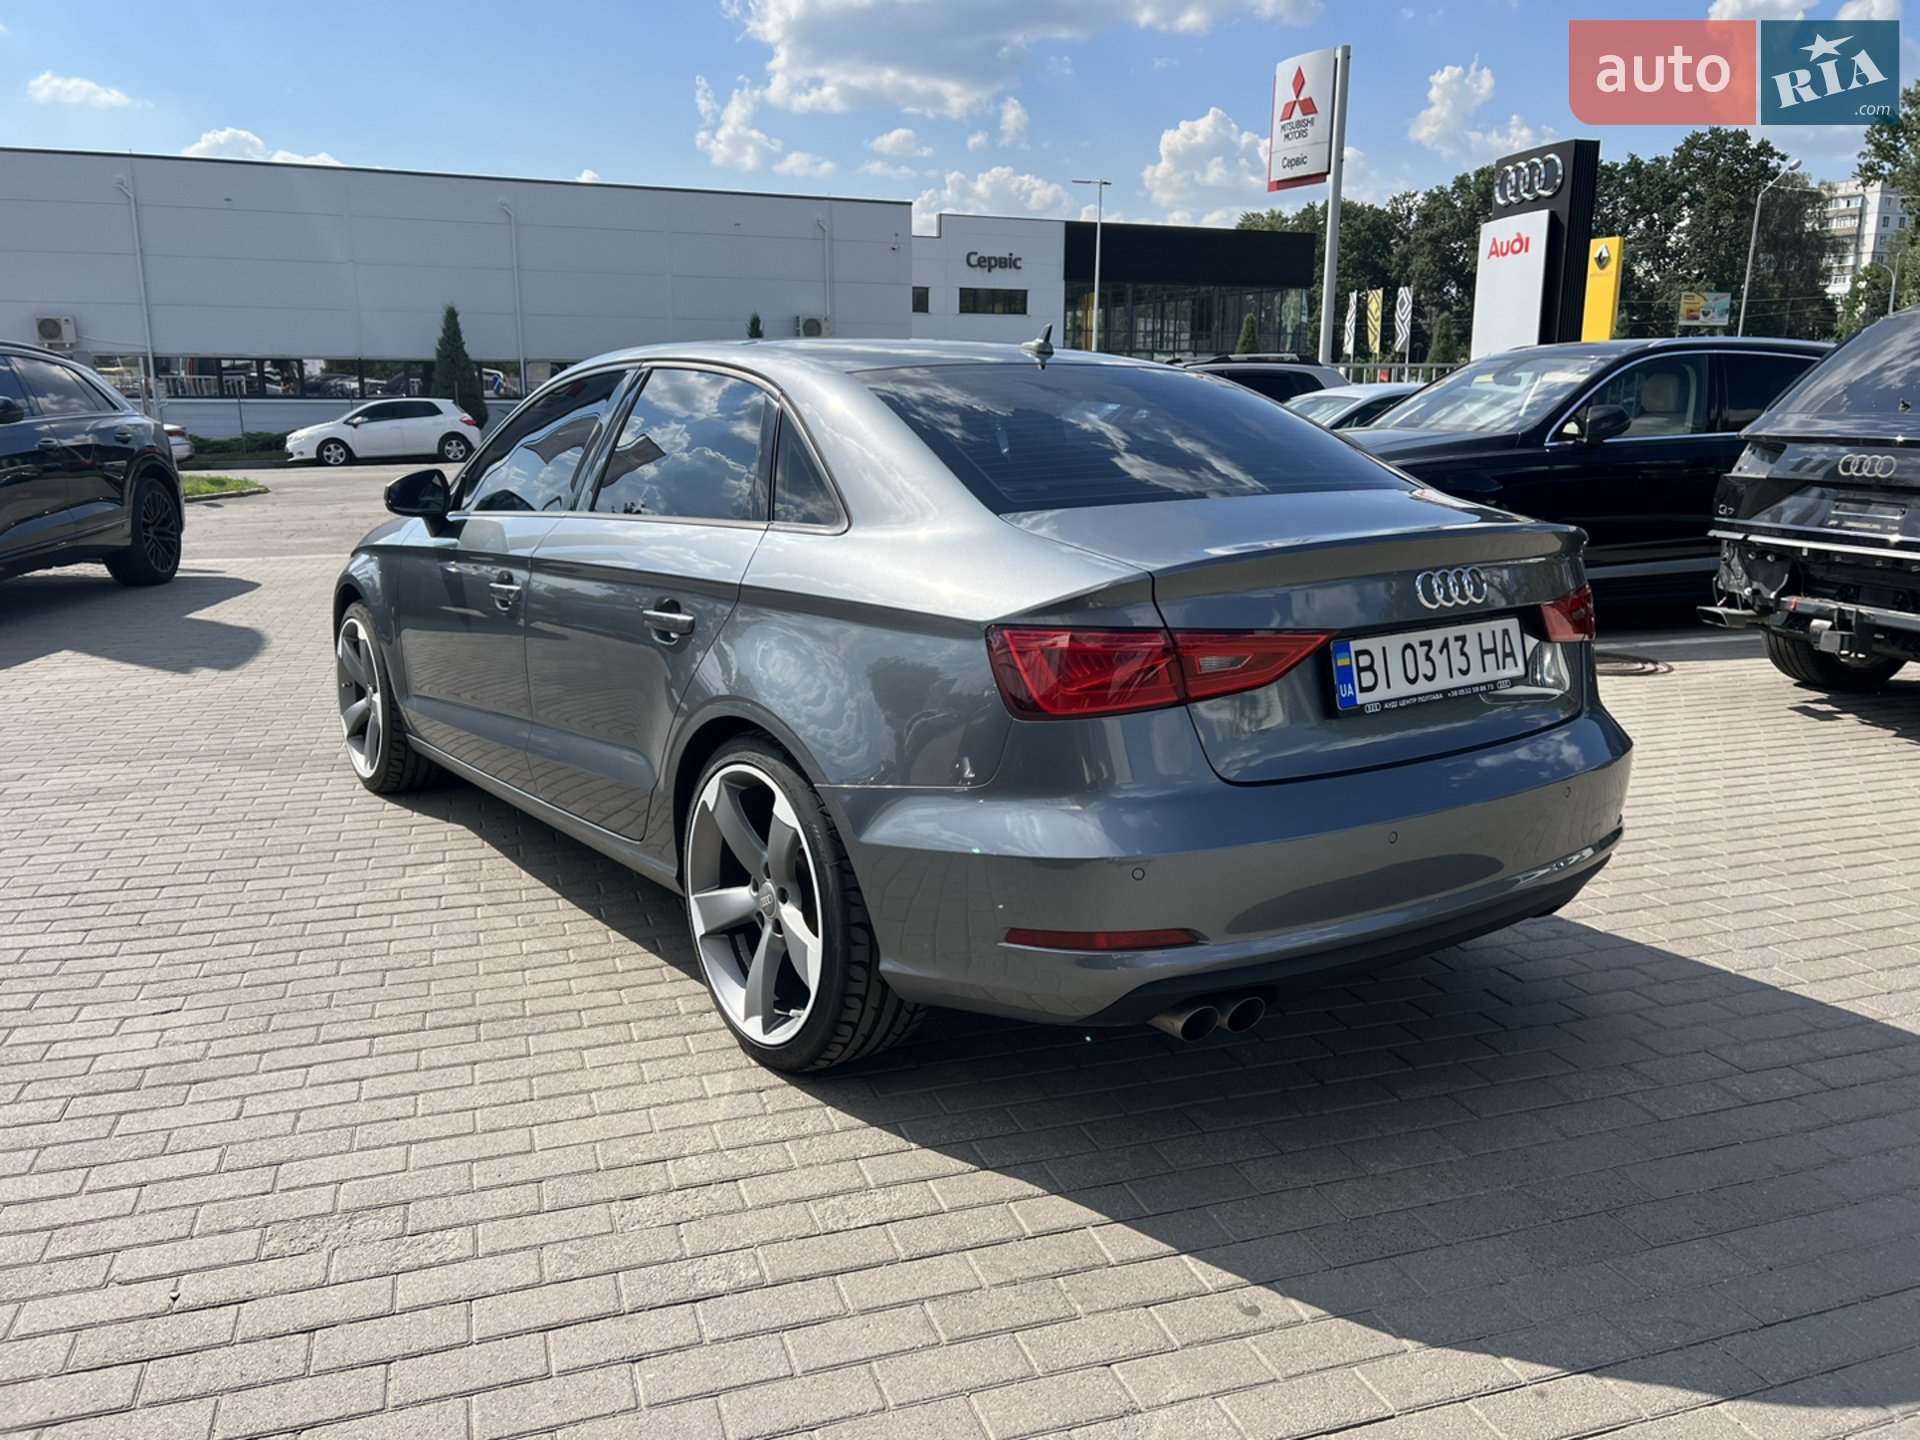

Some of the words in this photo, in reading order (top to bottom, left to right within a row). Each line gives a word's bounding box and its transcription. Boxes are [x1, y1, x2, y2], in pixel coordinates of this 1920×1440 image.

[1281, 116, 1314, 132] MITSUBISHI
[1284, 128, 1308, 142] MOTORS
[1281, 153, 1308, 170] Сервіс
[1487, 232, 1530, 260] Audi
[966, 251, 1022, 272] Сервіс
[1401, 634, 1471, 685] 0313
[1477, 628, 1518, 673] HA
[1340, 683, 1354, 698] UA
